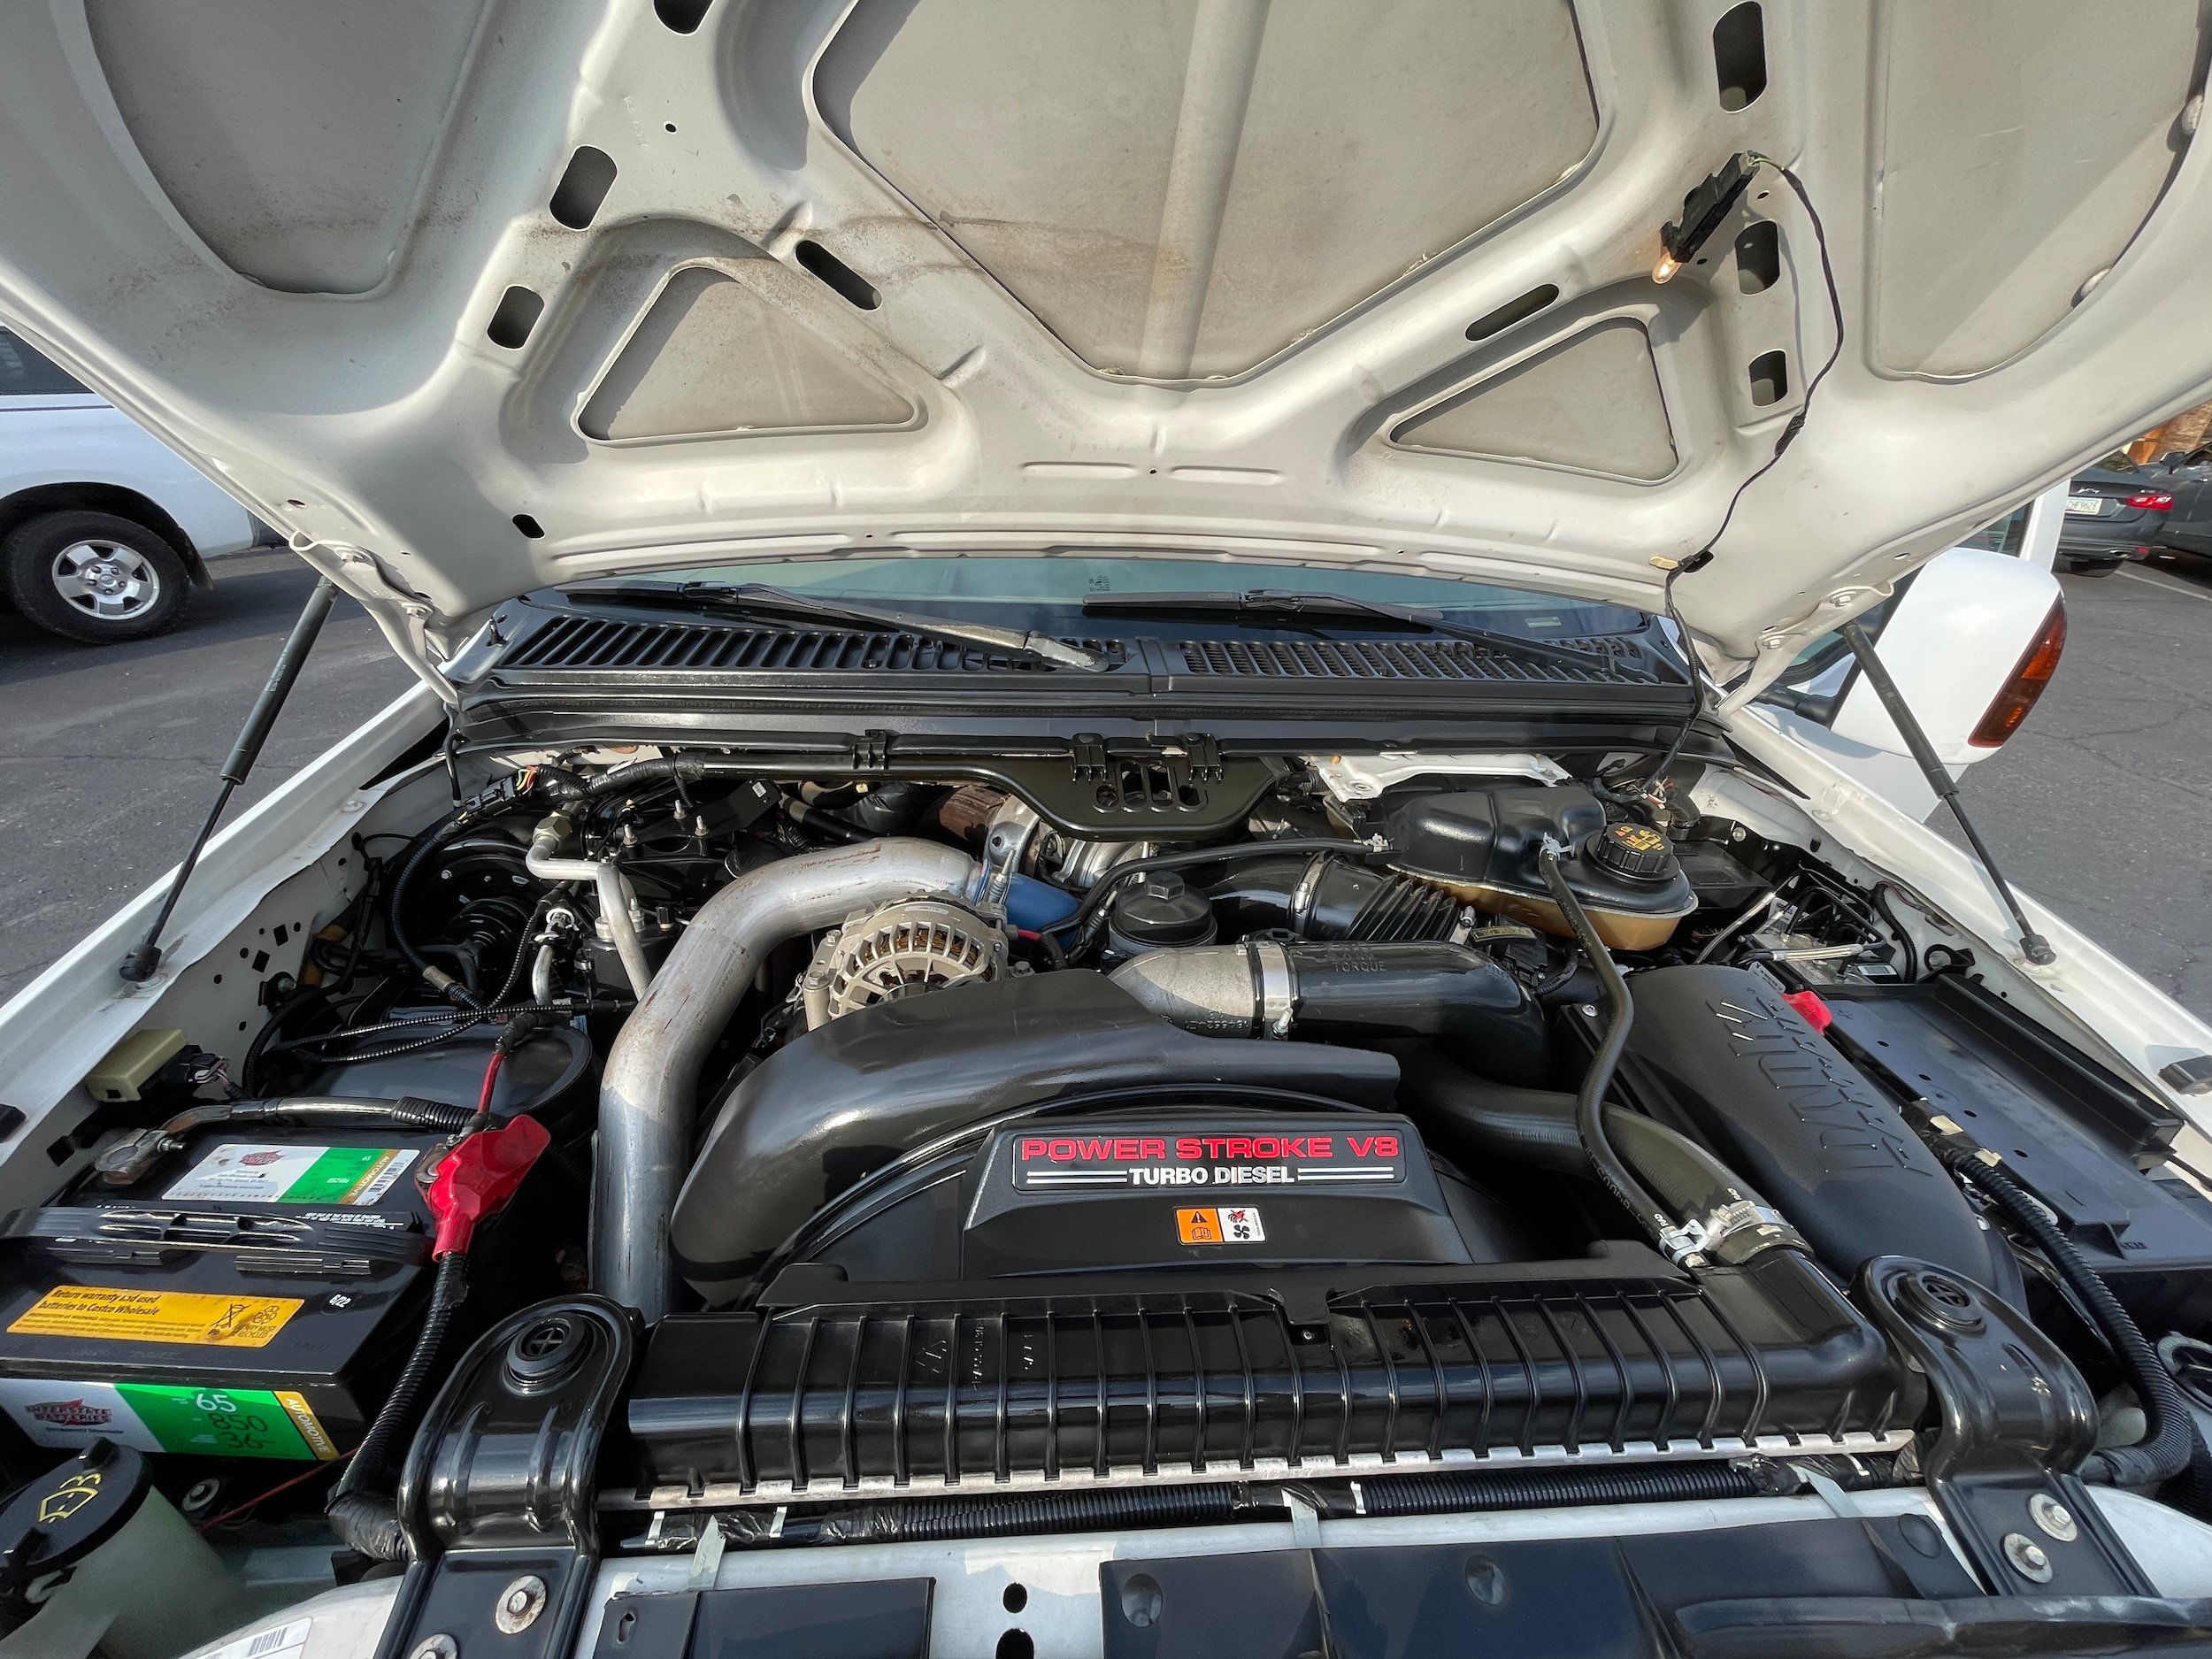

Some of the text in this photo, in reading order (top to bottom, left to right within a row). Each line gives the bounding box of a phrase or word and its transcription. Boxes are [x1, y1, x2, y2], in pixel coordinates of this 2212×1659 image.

[1332, 961, 1387, 972] TORQUE
[1021, 1135, 1400, 1161] POWER STROKE V8
[349, 1156, 390, 1197] AUTOMOTIVE
[1128, 1165, 1295, 1187] TURBO DIESEL
[1654, 1213, 1670, 1227] RAD
[50, 1289, 80, 1299] Return
[81, 1292, 118, 1303] warranty
[137, 1294, 161, 1303] used
[329, 1294, 351, 1309] 6/22
[38, 1300, 76, 1310] batteries
[88, 1303, 115, 1313] Costco
[115, 1305, 159, 1316] Wholesale
[196, 1393, 237, 1413] 65
[209, 1413, 269, 1432] 850
[286, 1398, 331, 1454] AUTOMOTIVE
